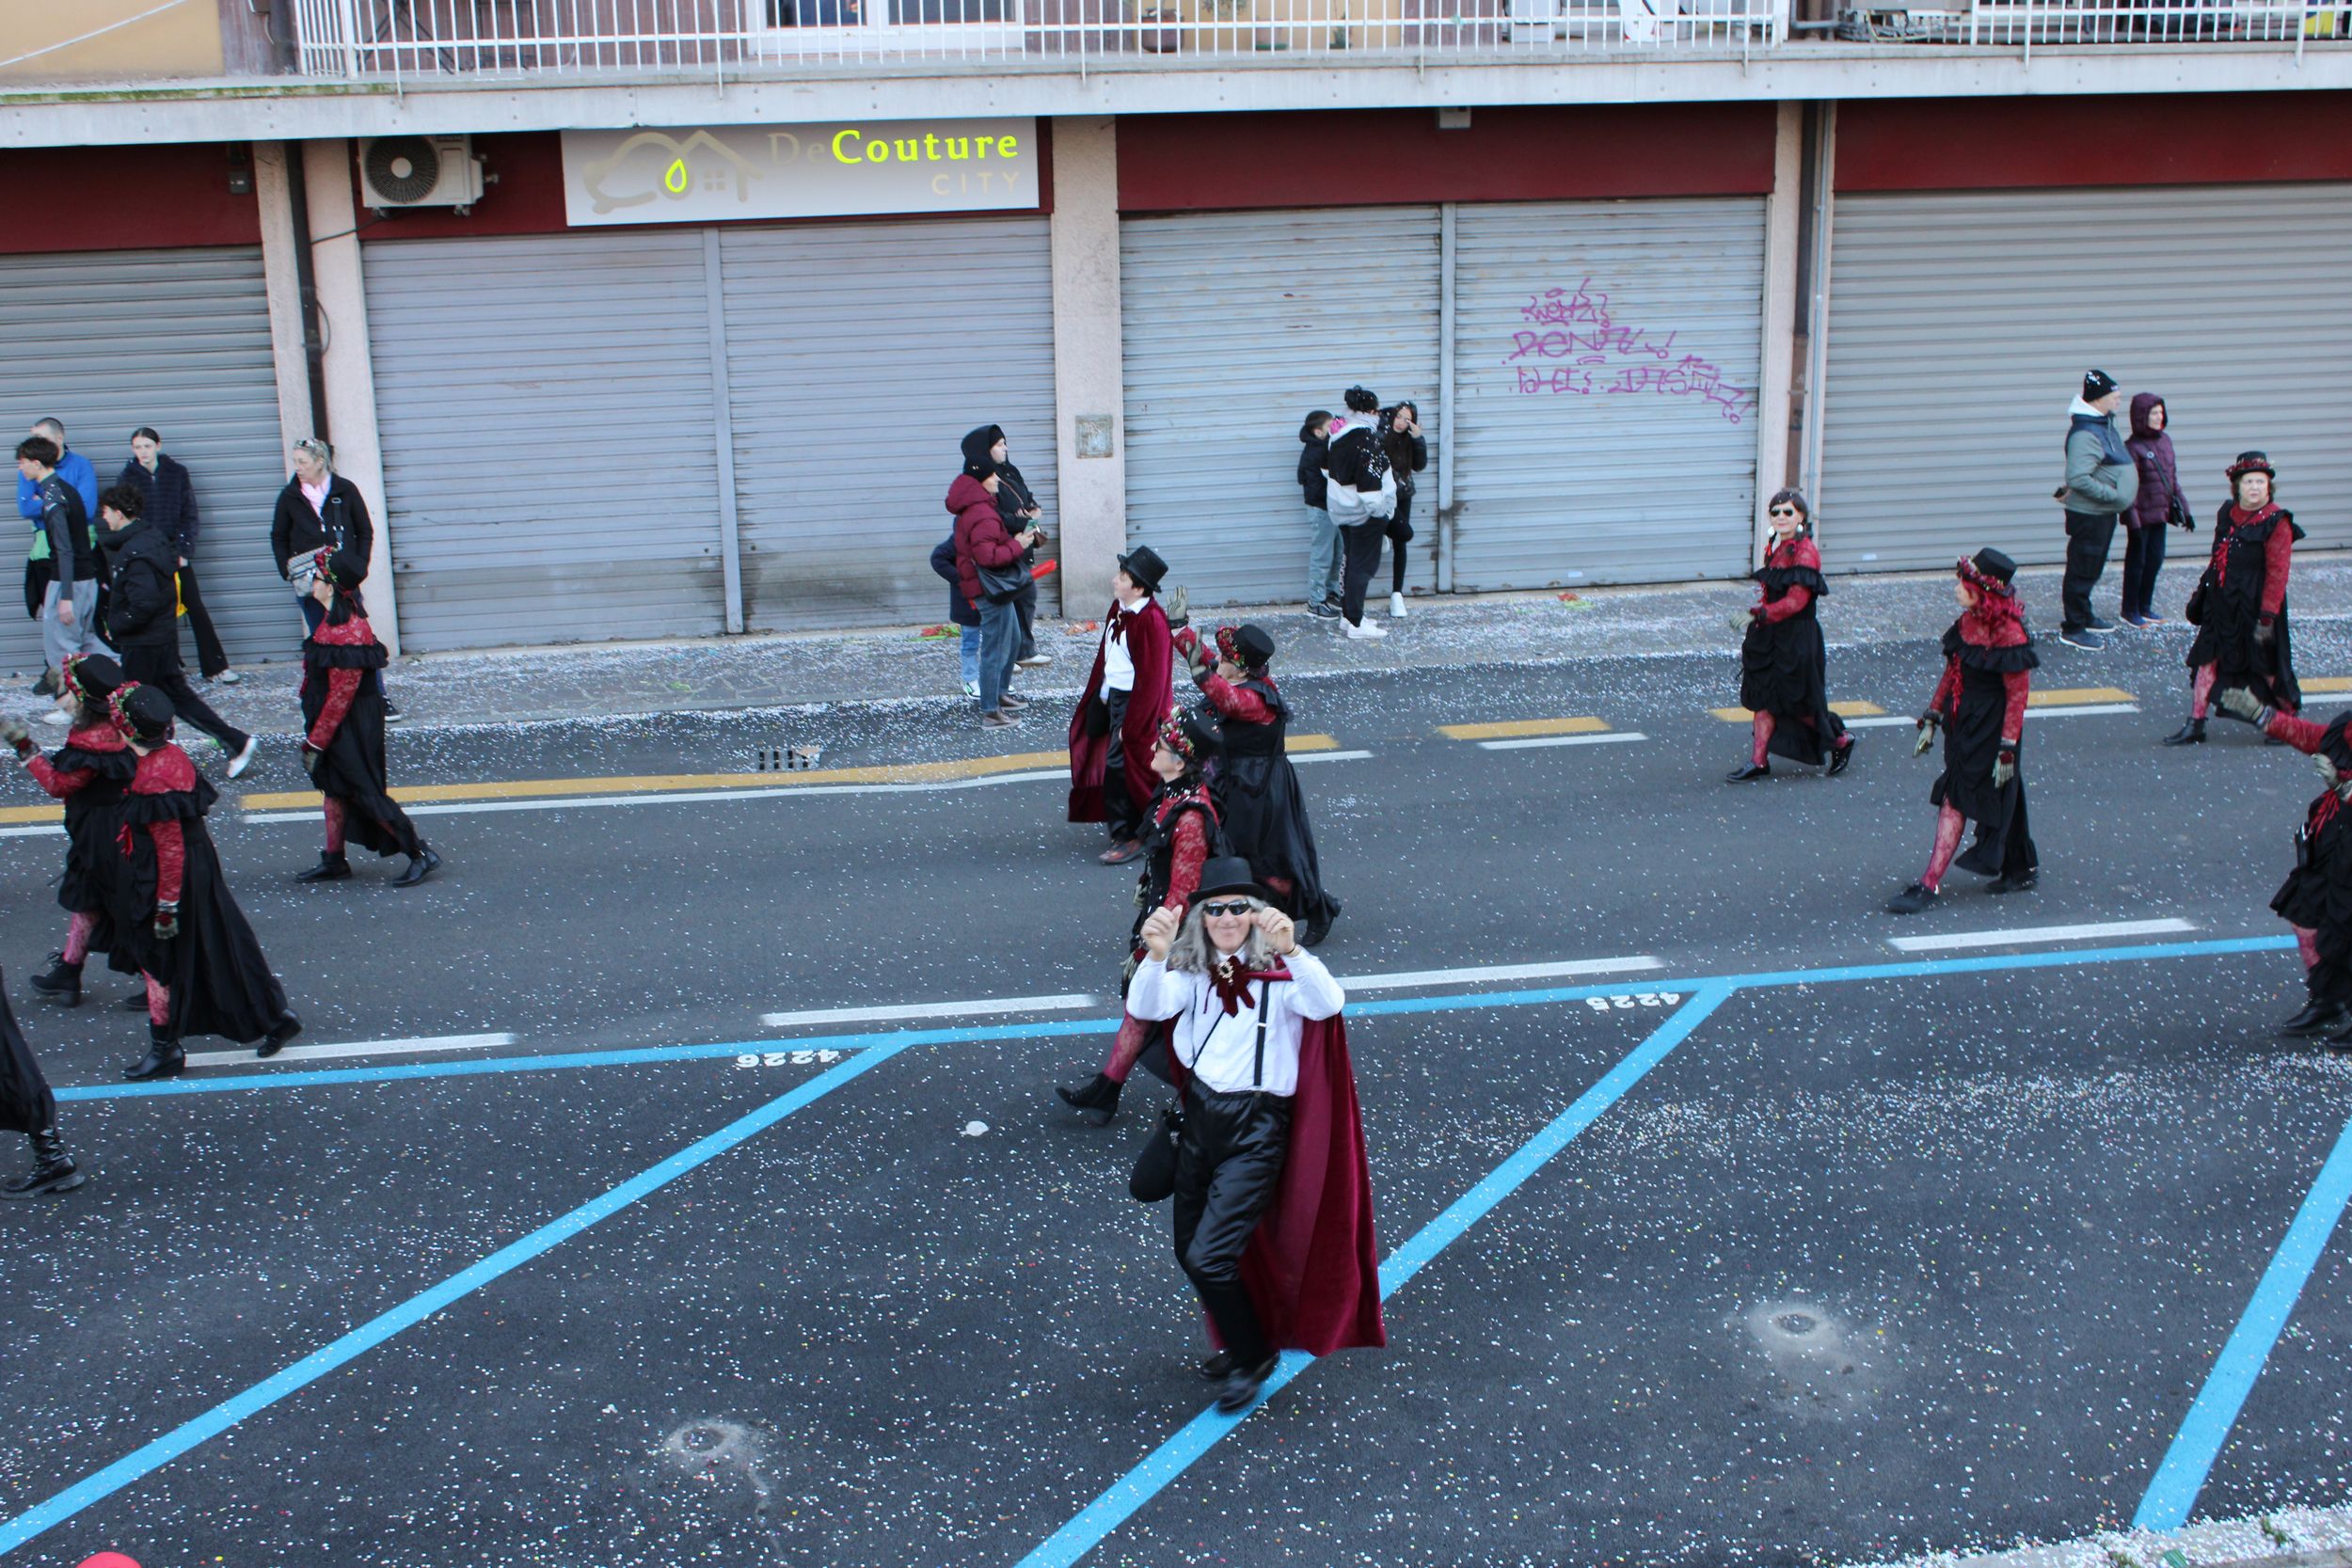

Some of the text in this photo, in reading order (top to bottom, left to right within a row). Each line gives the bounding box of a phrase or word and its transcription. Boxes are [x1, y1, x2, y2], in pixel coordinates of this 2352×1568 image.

[931, 171, 1019, 196] CITY
[1586, 991, 1680, 1011] 4225
[737, 1049, 839, 1069] 4226
